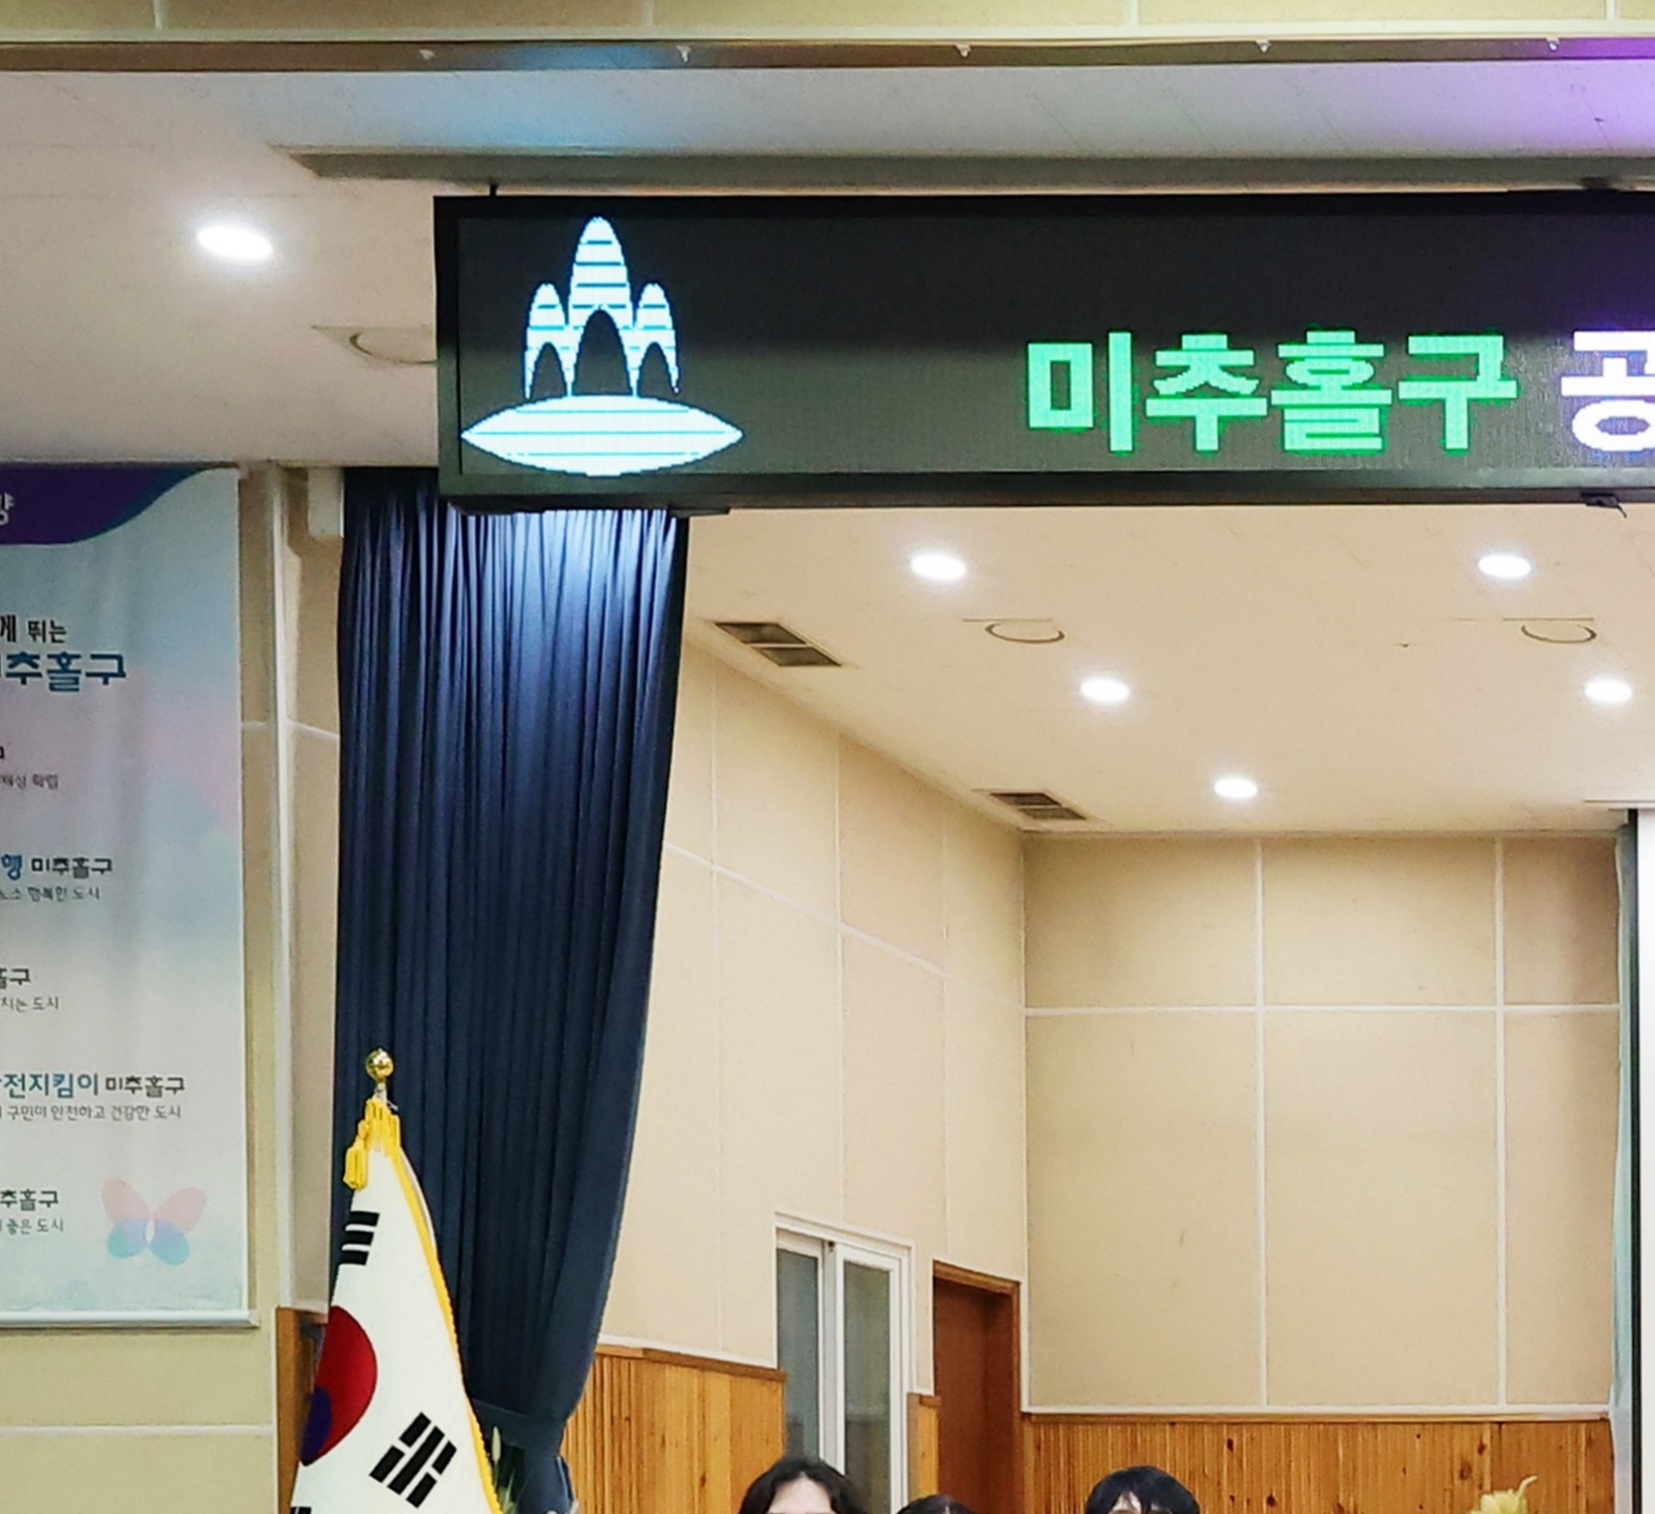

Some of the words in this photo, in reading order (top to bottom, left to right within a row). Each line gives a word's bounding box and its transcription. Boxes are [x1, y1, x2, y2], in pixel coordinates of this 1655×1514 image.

[1026, 330, 1519, 452] 미추홀구
[28, 619, 67, 644] 뛰는
[0, 651, 126, 692] 추홀구
[31, 857, 112, 879] 미추홀구
[0, 1073, 99, 1099] 전지킴이
[105, 1076, 185, 1098] 미추홀구
[153, 1105, 182, 1119] 도시
[37, 1218, 64, 1233] 도시
